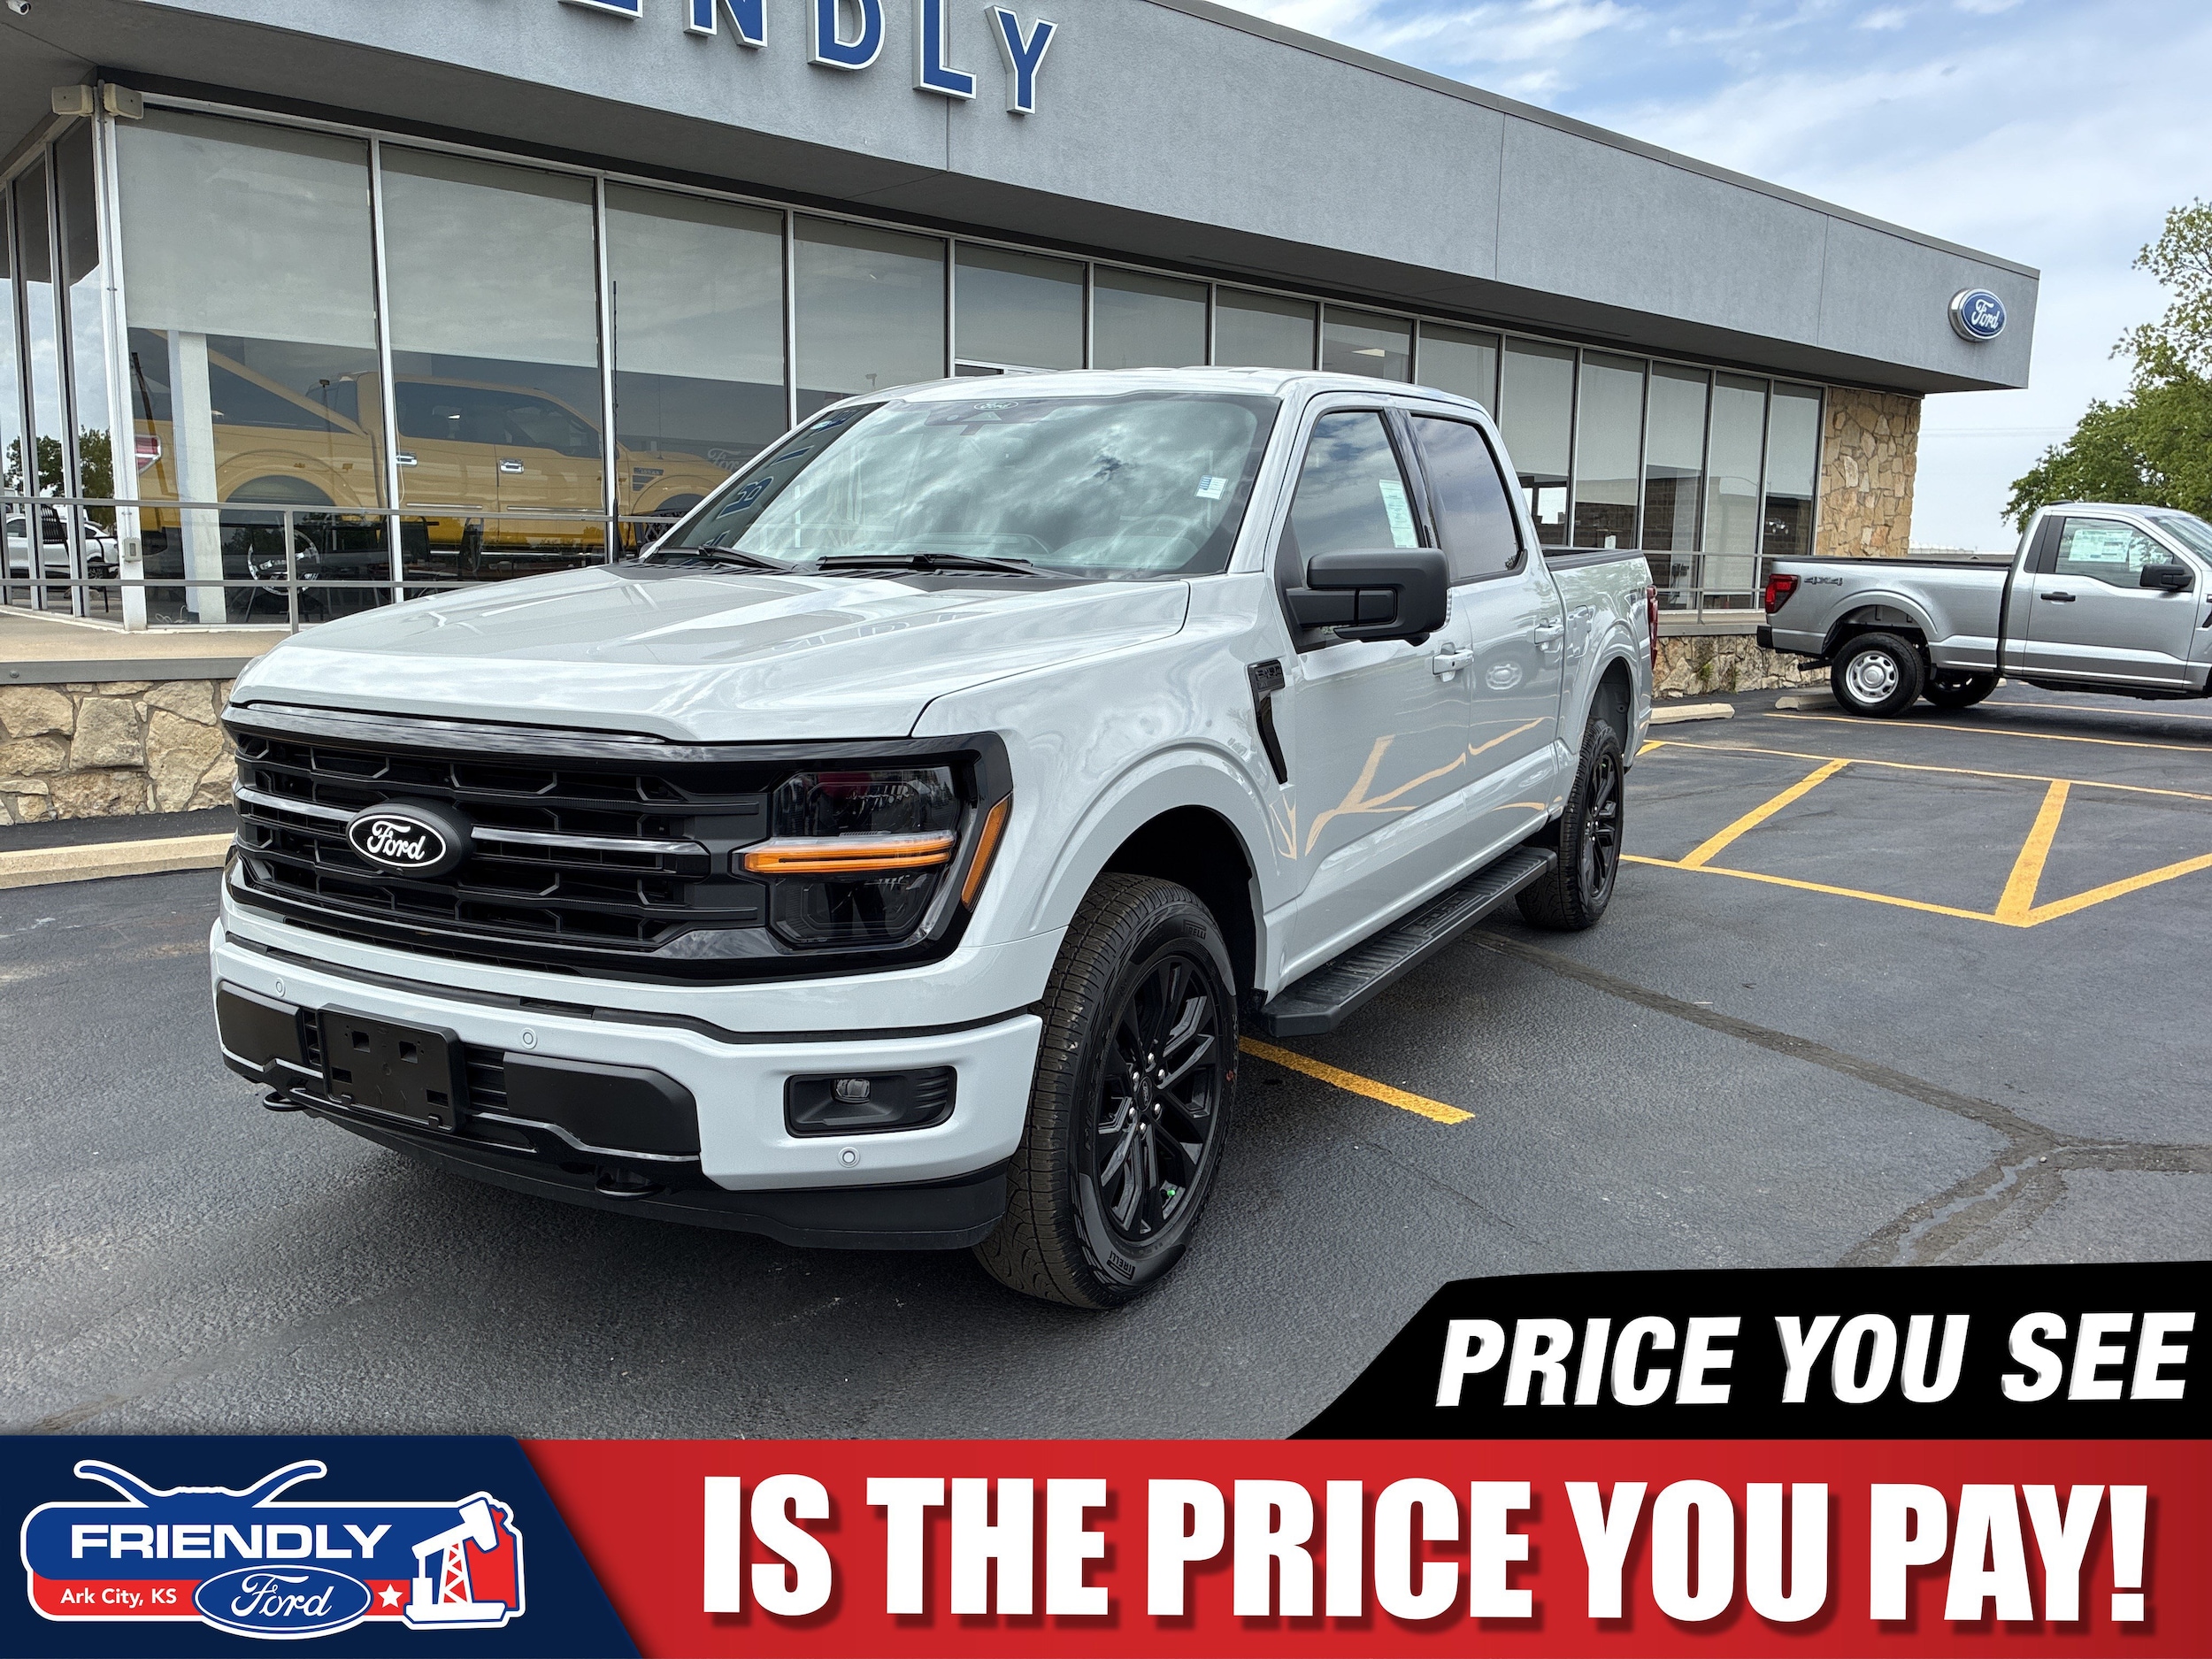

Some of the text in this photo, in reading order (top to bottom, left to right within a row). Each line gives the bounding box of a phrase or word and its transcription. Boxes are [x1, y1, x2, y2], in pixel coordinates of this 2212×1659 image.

[558, 0, 1058, 115] DLY
[1971, 298, 2001, 329] Ford
[366, 820, 426, 860] Ford
[1106, 1250, 1136, 1280] PIRELLI
